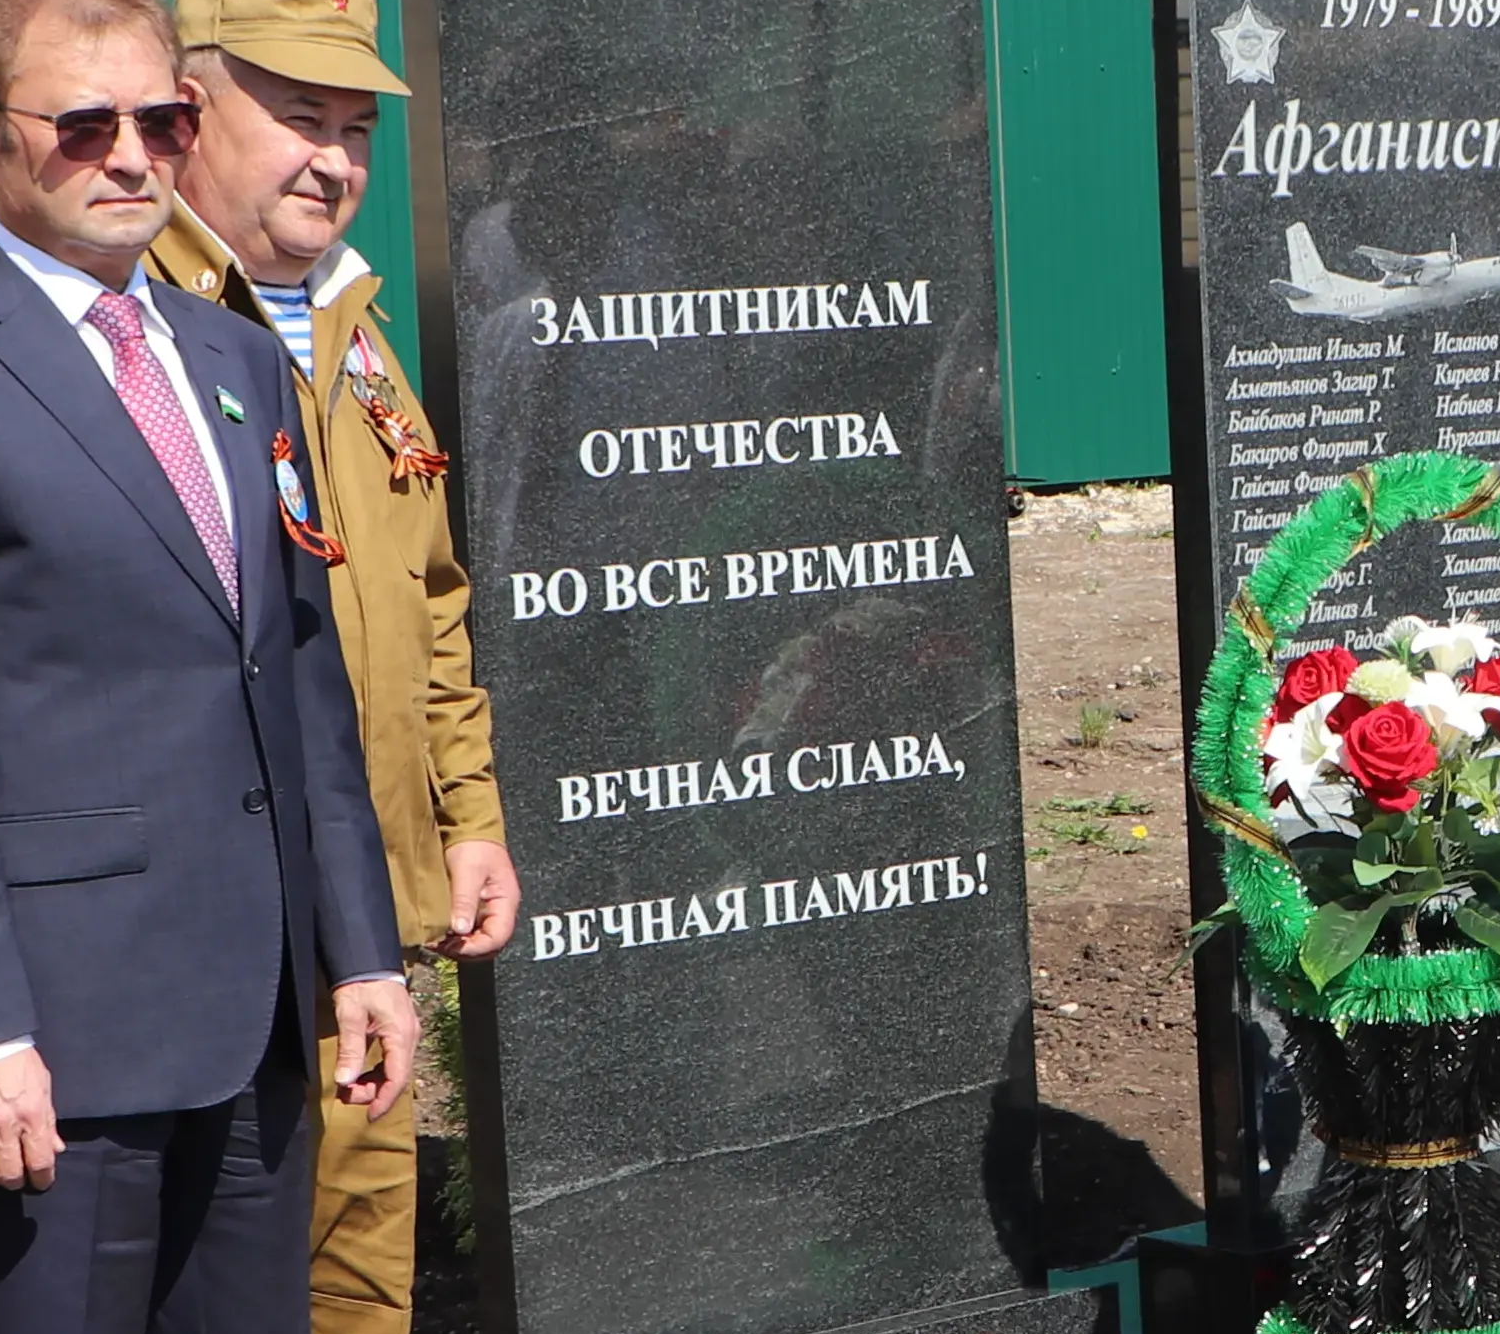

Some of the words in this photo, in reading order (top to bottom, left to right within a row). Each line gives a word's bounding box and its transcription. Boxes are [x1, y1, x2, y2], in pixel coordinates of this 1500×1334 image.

[531, 279, 933, 352] ЗАЩИТНИКАМ
[1224, 341, 1323, 370] Ахмадуллин
[1325, 337, 1382, 361] Ильгиз
[1225, 377, 1328, 401] Ахметьянов
[1331, 370, 1378, 396] Загир
[1434, 363, 1490, 390] Киреев
[1227, 407, 1305, 433] Байбаков
[1309, 404, 1364, 427] Ринат
[1435, 393, 1493, 417] Набиев
[579, 411, 901, 479] ОТЕЧЕСТВА
[1229, 442, 1299, 467] Бакиров
[1302, 438, 1368, 464] Флорит
[1230, 474, 1290, 500] Гайсин
[510, 566, 588, 621] ВО
[601, 556, 710, 613] ВСЕ
[723, 533, 975, 601] ВРЕМЕНА
[556, 751, 775, 824] ВЕЧНАЯ
[786, 731, 966, 794] СЛАВА,
[530, 885, 750, 962] ВЕЧНАЯ
[761, 851, 989, 928] ПАМЯТЬ!
